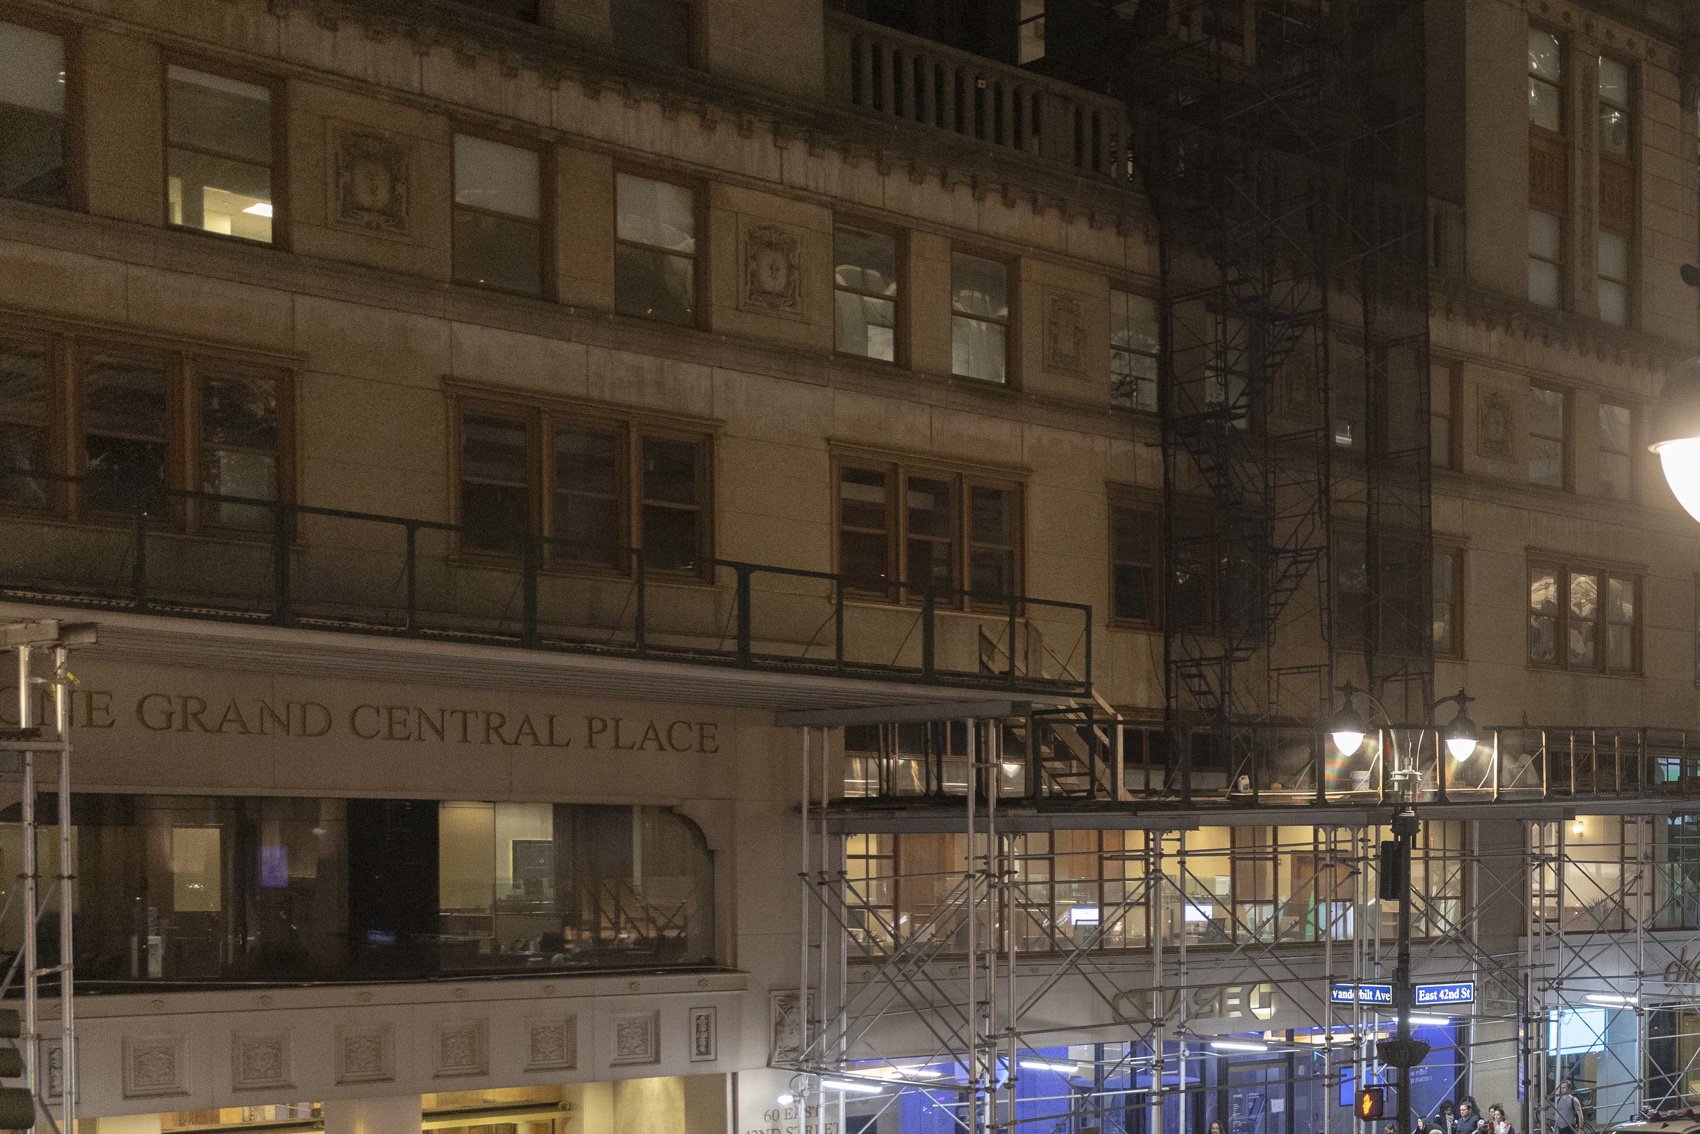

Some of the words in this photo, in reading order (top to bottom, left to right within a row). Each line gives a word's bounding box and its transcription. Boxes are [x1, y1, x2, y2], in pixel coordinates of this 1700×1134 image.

[136, 692, 333, 738] GRAND
[350, 703, 572, 749] CENTRAL
[584, 714, 720, 755] PLACE
[1375, 989, 1391, 1001] Ave
[1418, 989, 1438, 1001] East
[1439, 988, 1460, 1000] 42nd
[1460, 987, 1471, 999] St
[764, 1109, 780, 1123] 60
